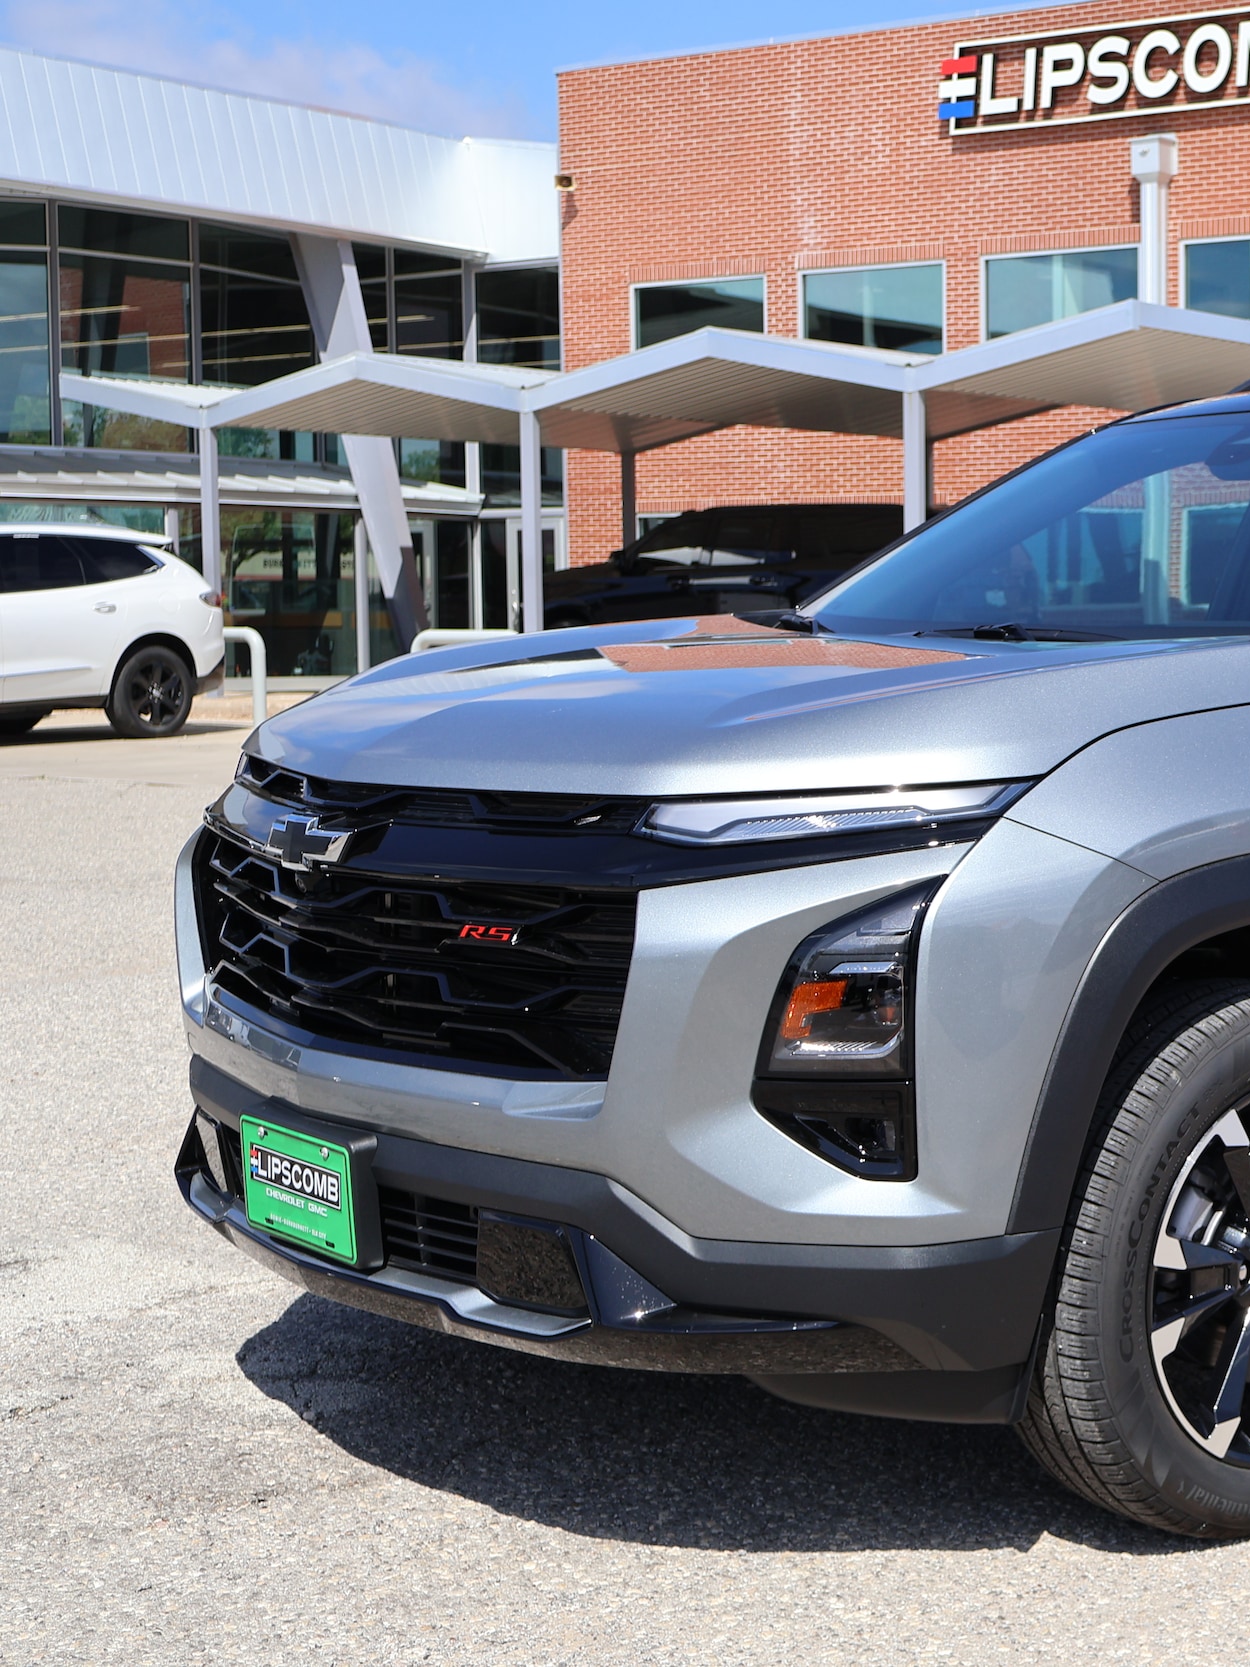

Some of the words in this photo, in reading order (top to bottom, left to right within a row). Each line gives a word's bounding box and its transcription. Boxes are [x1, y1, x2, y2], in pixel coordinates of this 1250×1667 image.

[459, 924, 513, 942] RS
[257, 1150, 339, 1203] LIPSCOMB
[265, 1187, 305, 1209] CHEVROLET
[307, 1202, 328, 1217] GMC
